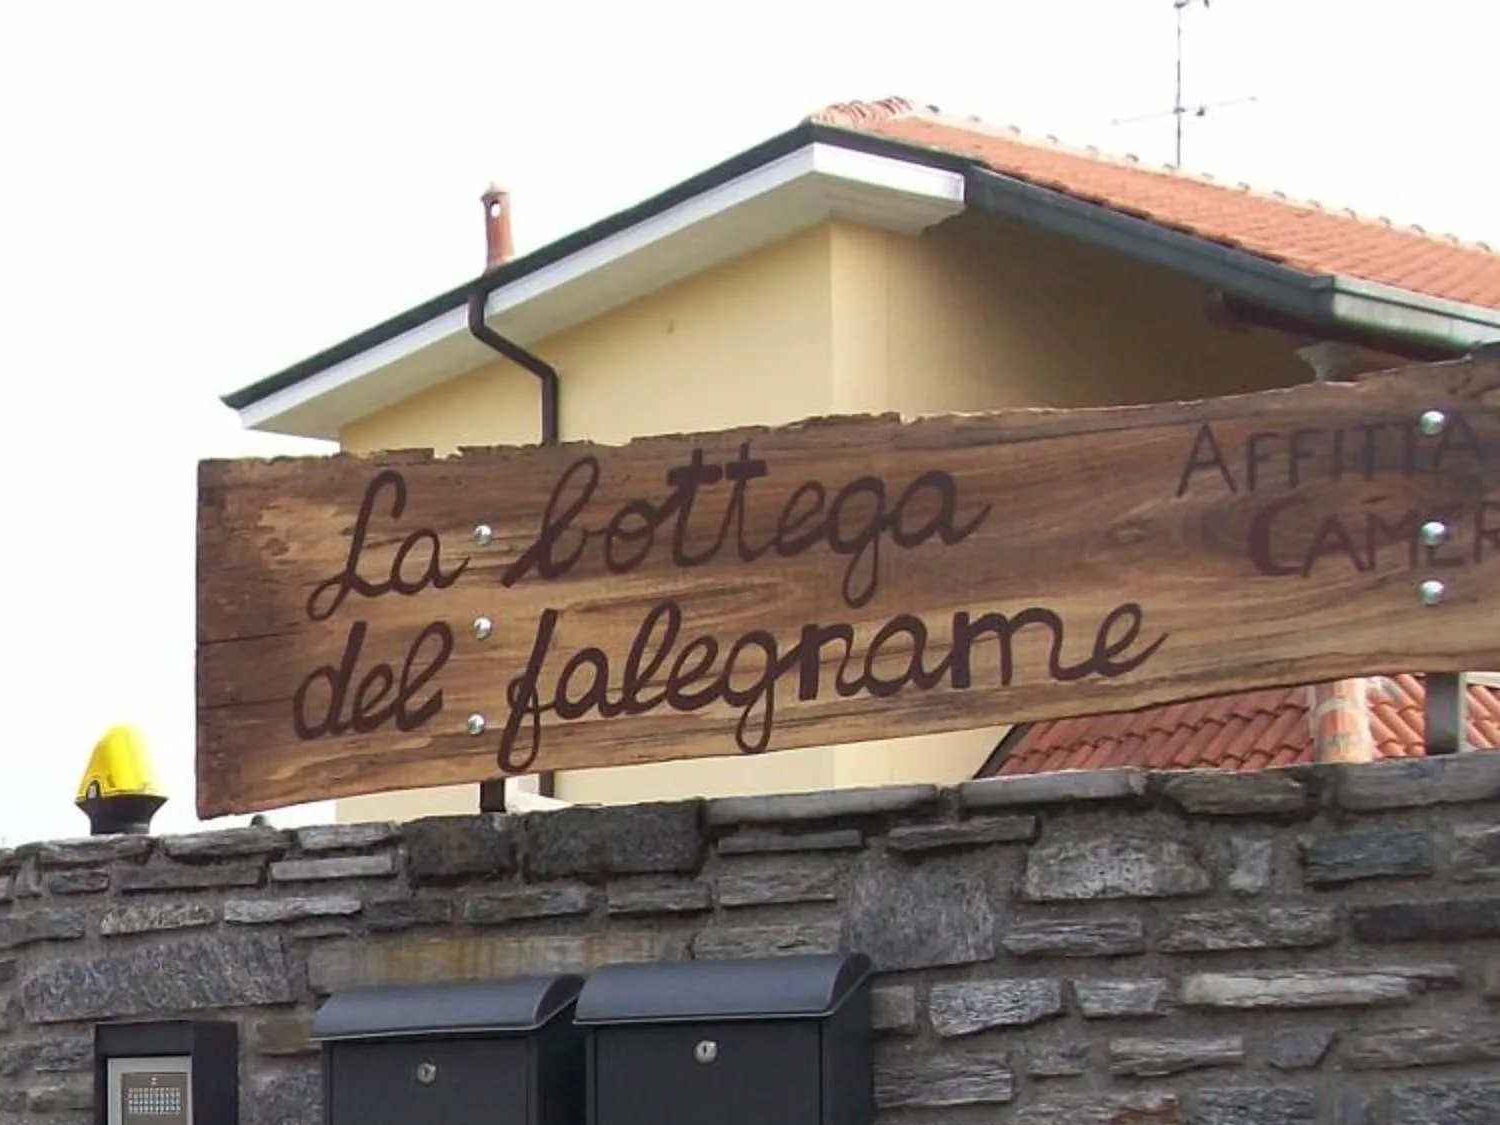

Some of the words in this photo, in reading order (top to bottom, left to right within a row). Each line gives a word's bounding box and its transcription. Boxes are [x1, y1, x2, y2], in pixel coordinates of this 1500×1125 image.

[307, 471, 470, 622] La
[503, 439, 991, 608] bottega
[294, 620, 454, 741] del
[497, 601, 1169, 773] falegname
